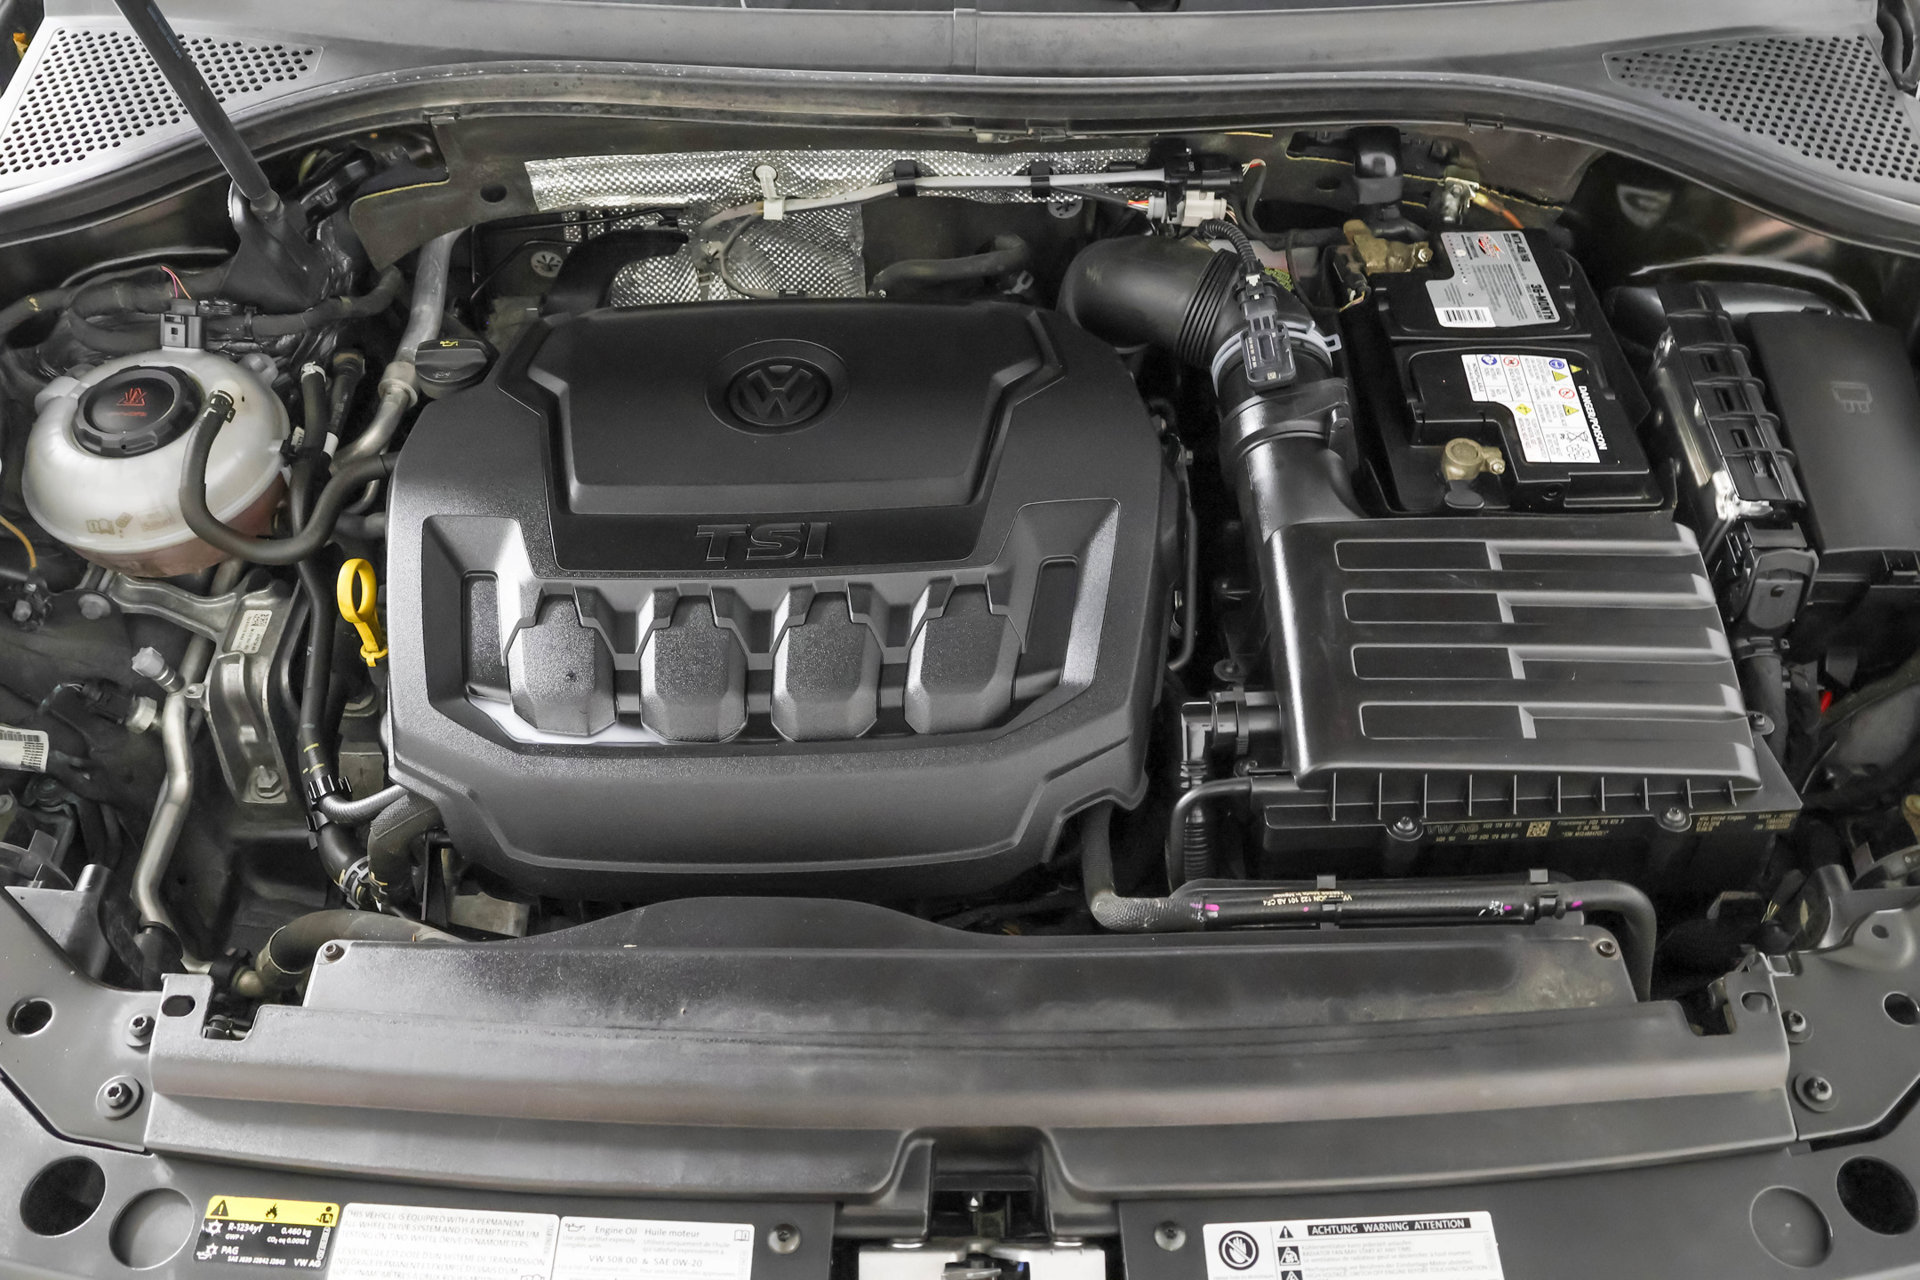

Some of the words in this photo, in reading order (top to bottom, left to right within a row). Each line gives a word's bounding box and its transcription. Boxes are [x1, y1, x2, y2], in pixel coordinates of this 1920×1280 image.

[1578, 385, 1608, 451] DANGER/POISON
[696, 522, 832, 562] TSI
[365, 1211, 395, 1220] VEHICLE
[406, 1214, 446, 1222] EQUIPPED
[477, 1218, 524, 1226] PERMANENT
[228, 1222, 263, 1234] R-1234yf
[281, 1227, 302, 1236] 0.460
[302, 1229, 312, 1238] kg
[595, 1226, 624, 1236] Engine
[625, 1226, 638, 1235] Oil
[644, 1228, 668, 1236] Huile
[1312, 1224, 1358, 1235] ACHTUNG
[1362, 1221, 1410, 1232] WARNING
[1414, 1220, 1465, 1230] ATTENTION
[220, 1246, 240, 1256] PAG
[294, 1258, 308, 1268] VW
[308, 1260, 322, 1268] AG
[607, 1256, 623, 1264] 508
